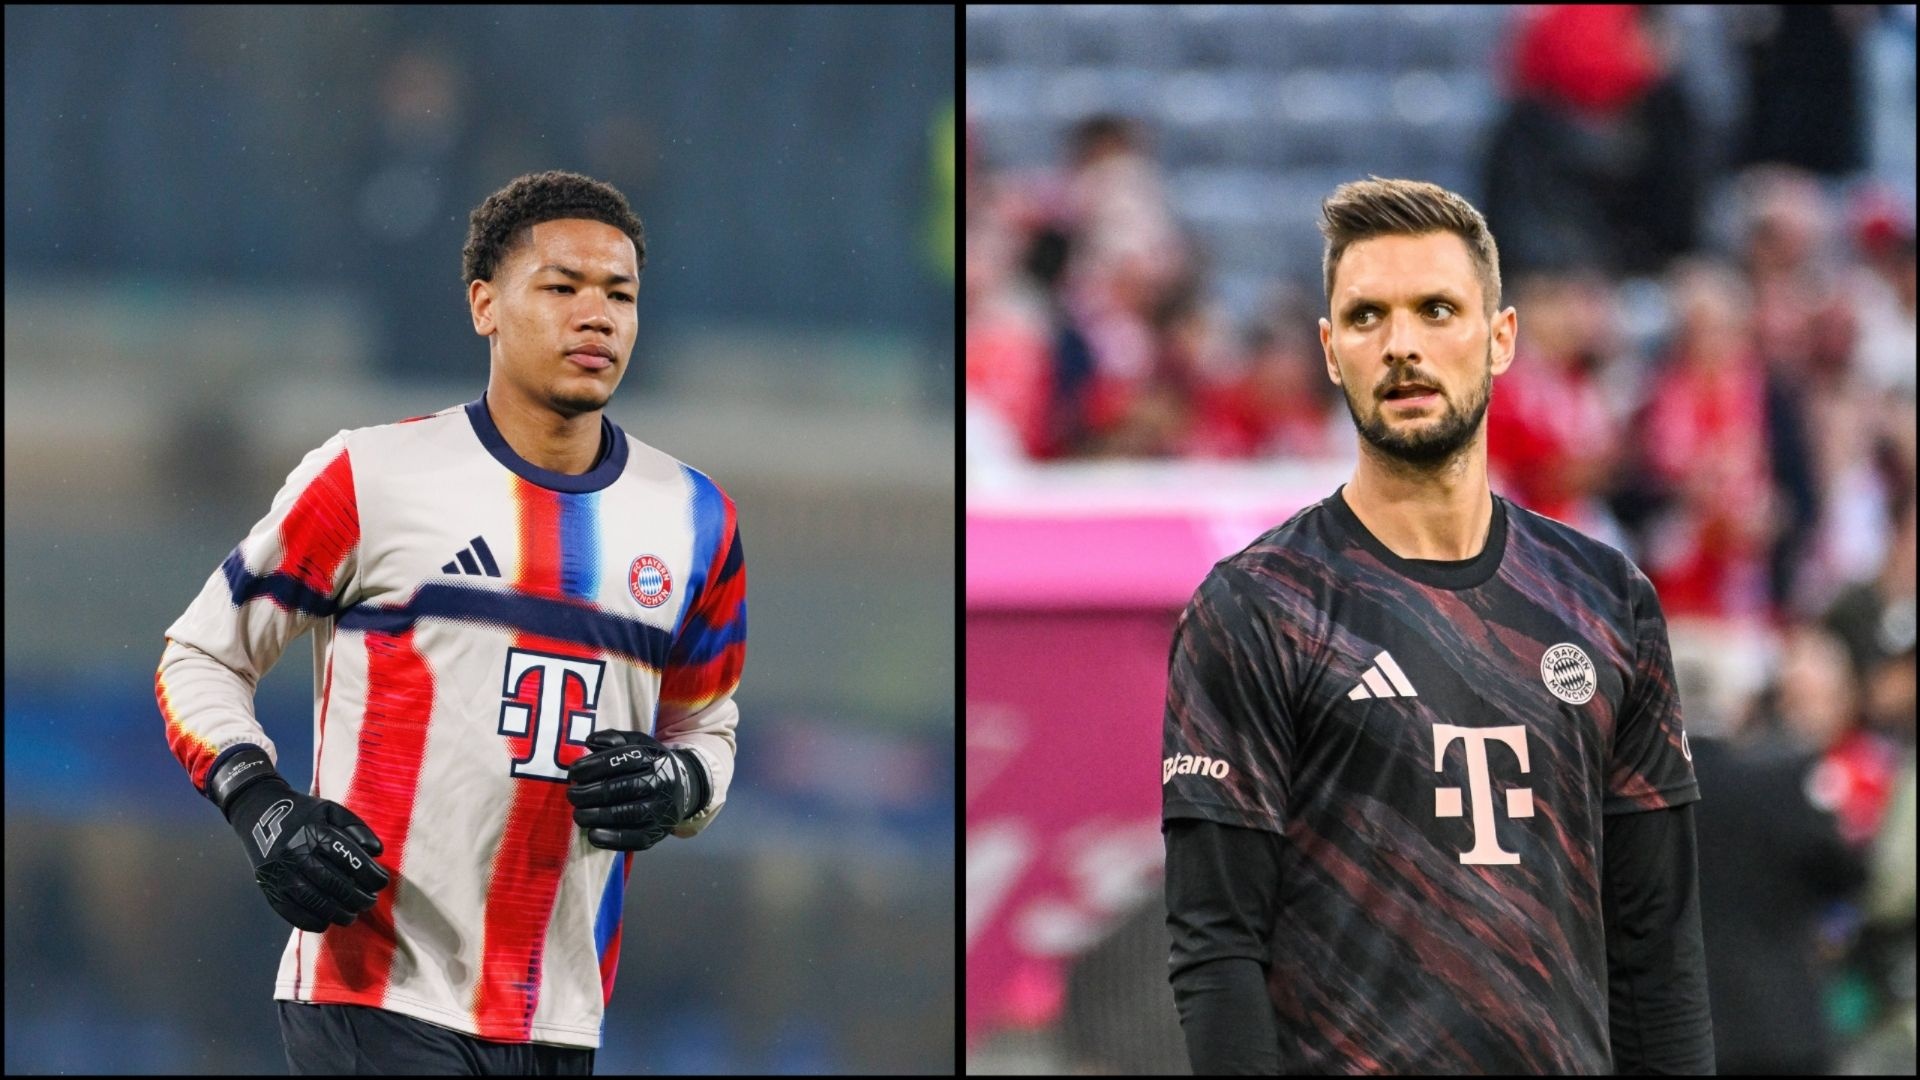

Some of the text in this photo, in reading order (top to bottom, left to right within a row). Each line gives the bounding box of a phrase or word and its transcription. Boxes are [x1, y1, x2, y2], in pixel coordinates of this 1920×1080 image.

[632, 558, 670, 581] FC BAYERN
[1545, 649, 1590, 670] FC BAYERN
[1163, 751, 1230, 785] tano
[1432, 723, 1535, 864] T
